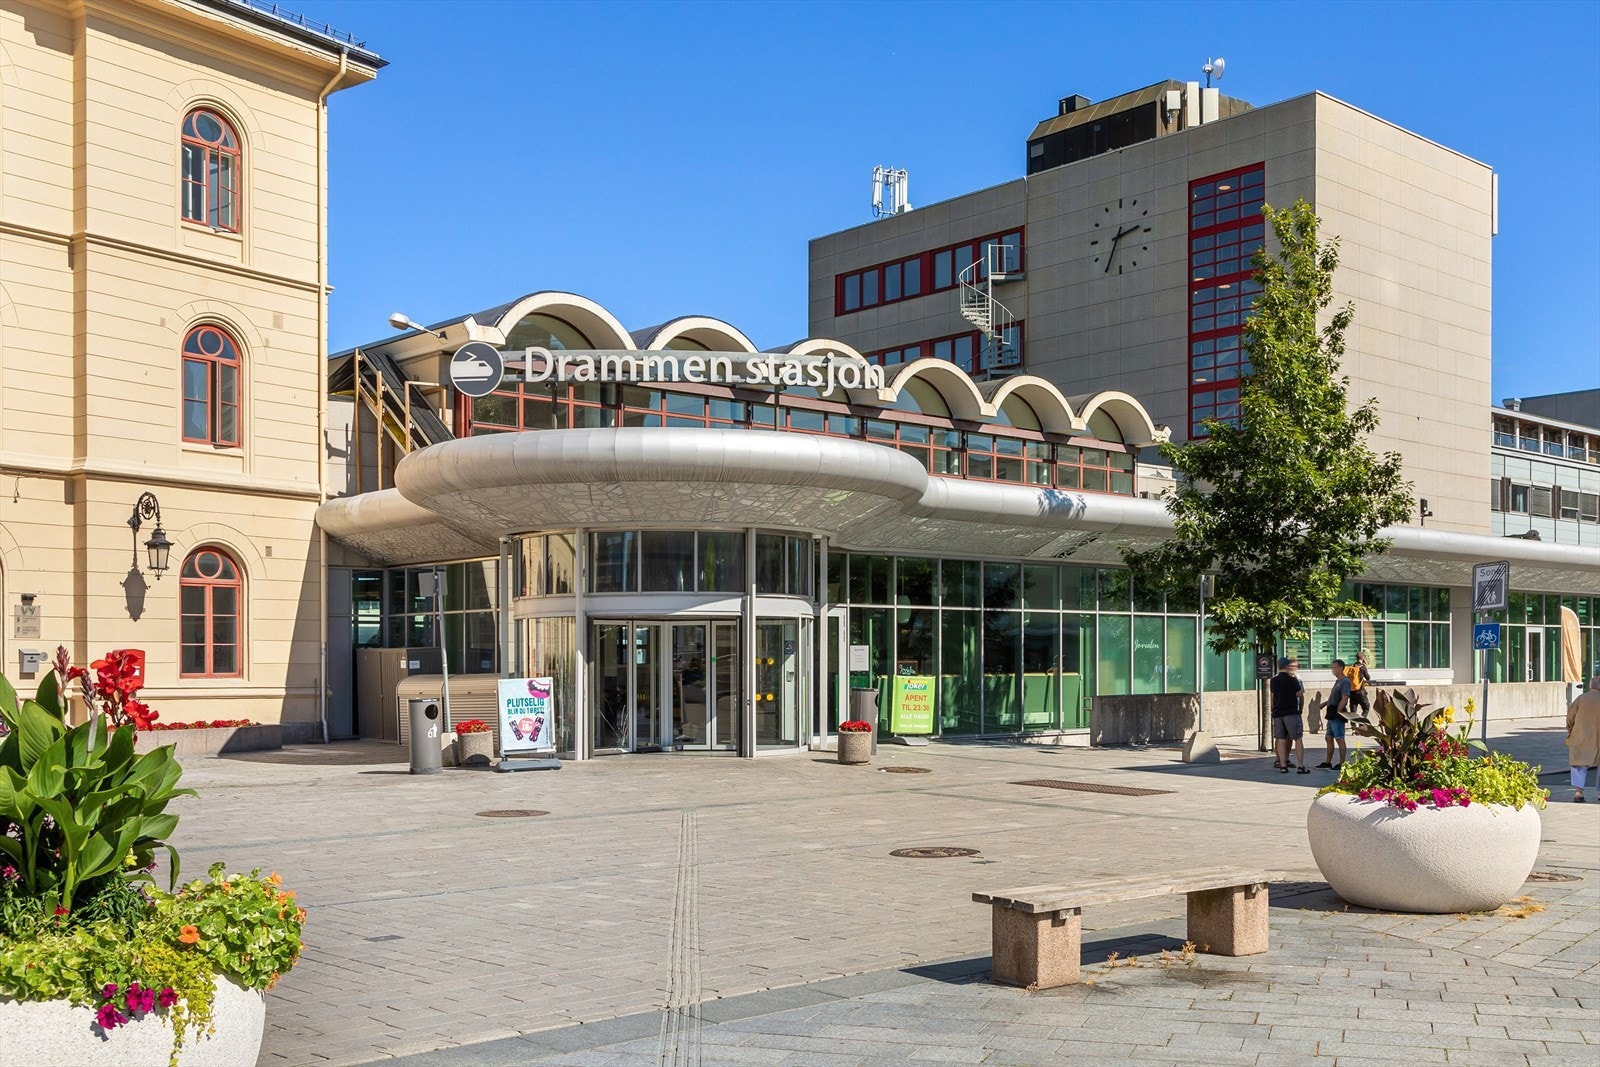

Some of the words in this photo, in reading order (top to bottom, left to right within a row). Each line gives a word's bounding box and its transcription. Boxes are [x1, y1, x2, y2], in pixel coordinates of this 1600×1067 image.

[525, 346, 733, 383] Drammen
[746, 352, 886, 397] stasjon
[507, 697, 545, 708] PLUTSELIG
[905, 694, 927, 702] ÅPENT
